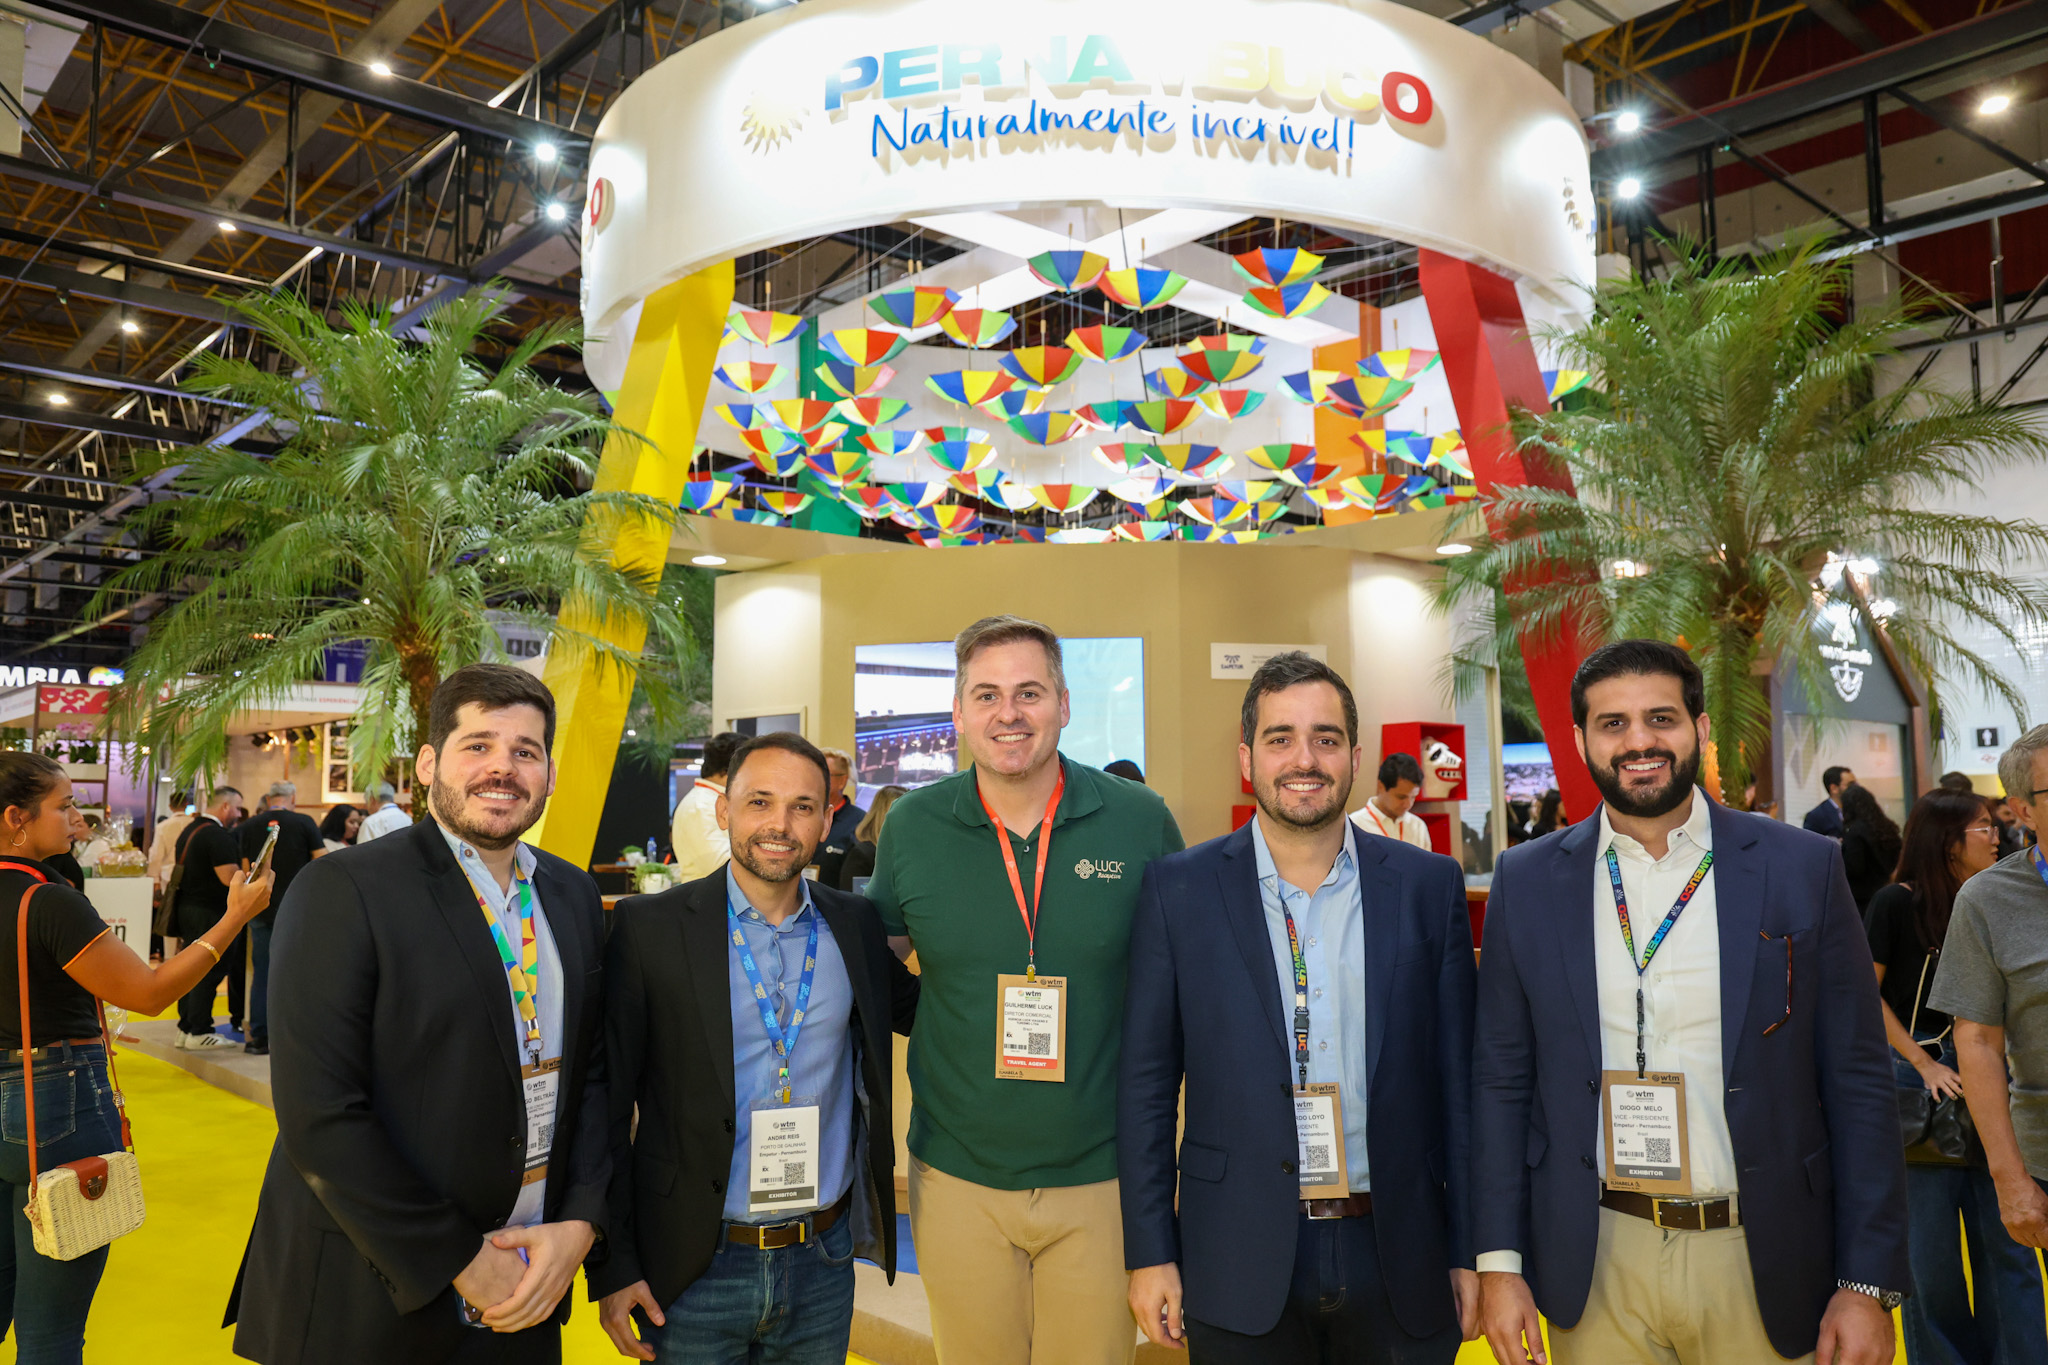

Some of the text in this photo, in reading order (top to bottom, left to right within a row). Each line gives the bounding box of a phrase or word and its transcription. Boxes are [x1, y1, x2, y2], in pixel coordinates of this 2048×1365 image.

[824, 34, 1433, 124] PERNABUCO
[872, 99, 1356, 159] Naturalmente incrível!
[1095, 859, 1123, 874] LUCK
[533, 1080, 546, 1088] wtm
[768, 1191, 798, 1199] EXHIBITOR
